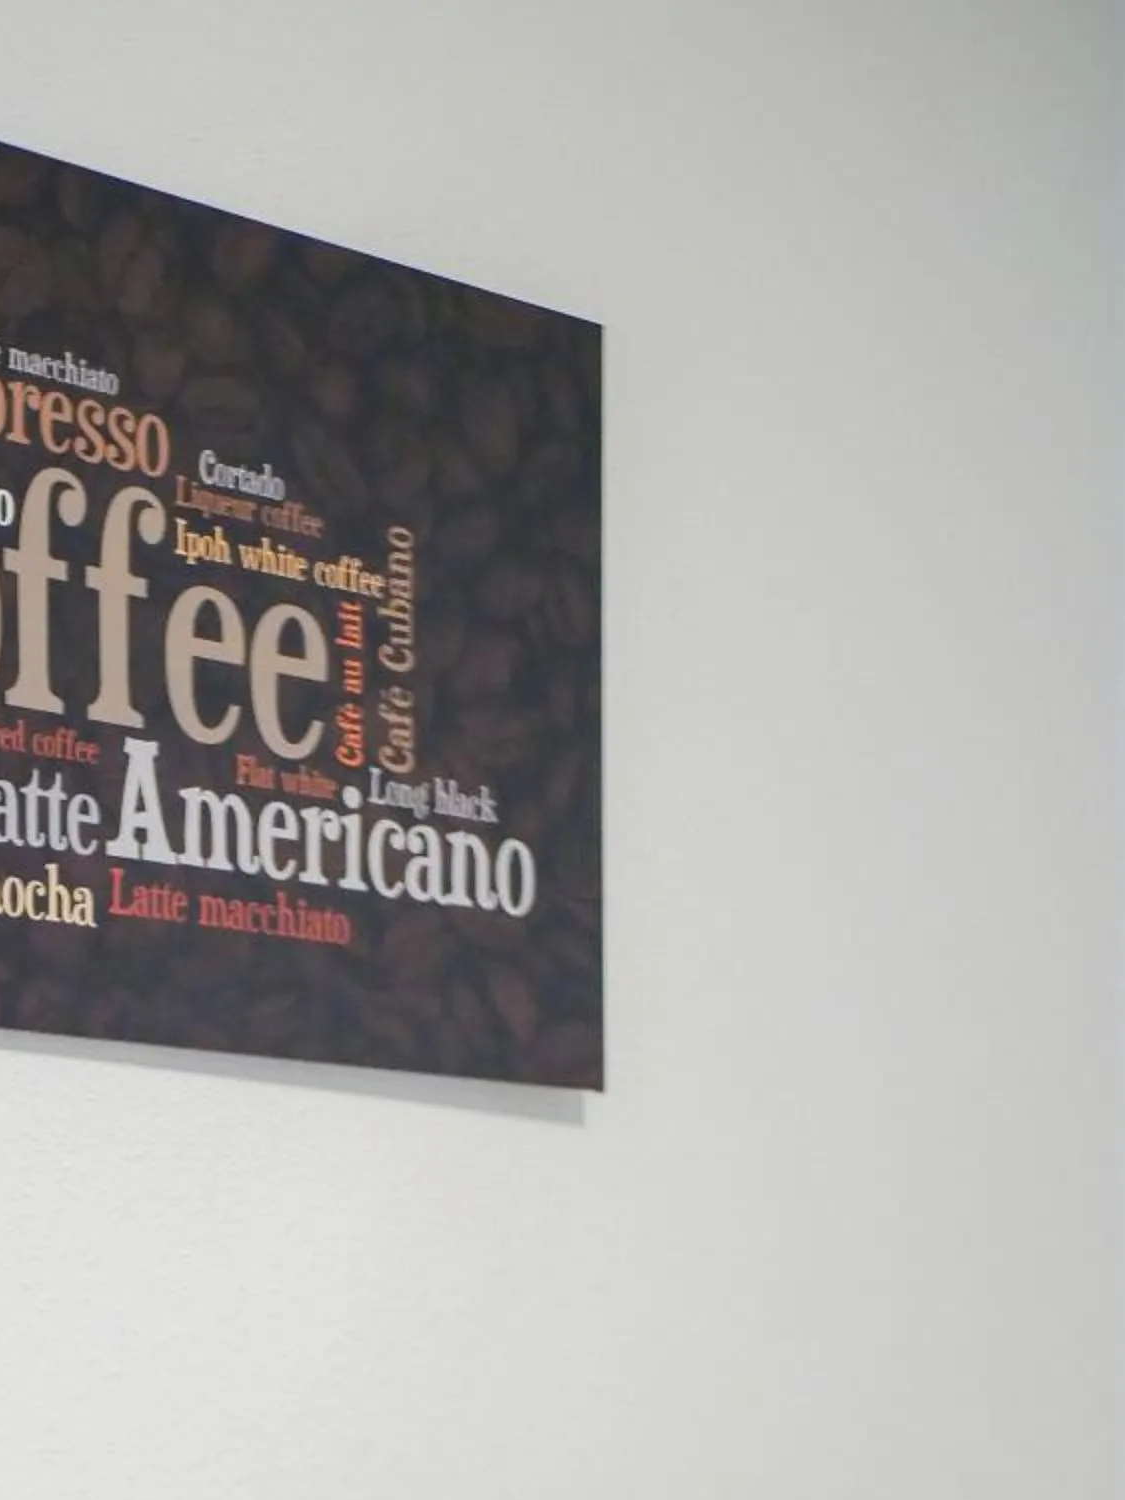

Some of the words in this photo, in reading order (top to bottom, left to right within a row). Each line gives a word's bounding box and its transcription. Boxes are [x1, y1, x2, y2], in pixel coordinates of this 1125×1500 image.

[8, 347, 119, 395] macchiato
[198, 449, 286, 500] Cortado
[260, 500, 324, 539] coffee
[174, 517, 232, 566] Ipoh
[238, 536, 308, 582] white
[313, 555, 386, 599] coffee
[376, 525, 415, 673] Cubano
[31, 727, 101, 765] coffee
[367, 766, 430, 819] Long
[433, 777, 499, 823] black
[106, 736, 537, 918] Americano
[108, 867, 188, 923] Latte
[198, 893, 352, 945] macchiato
